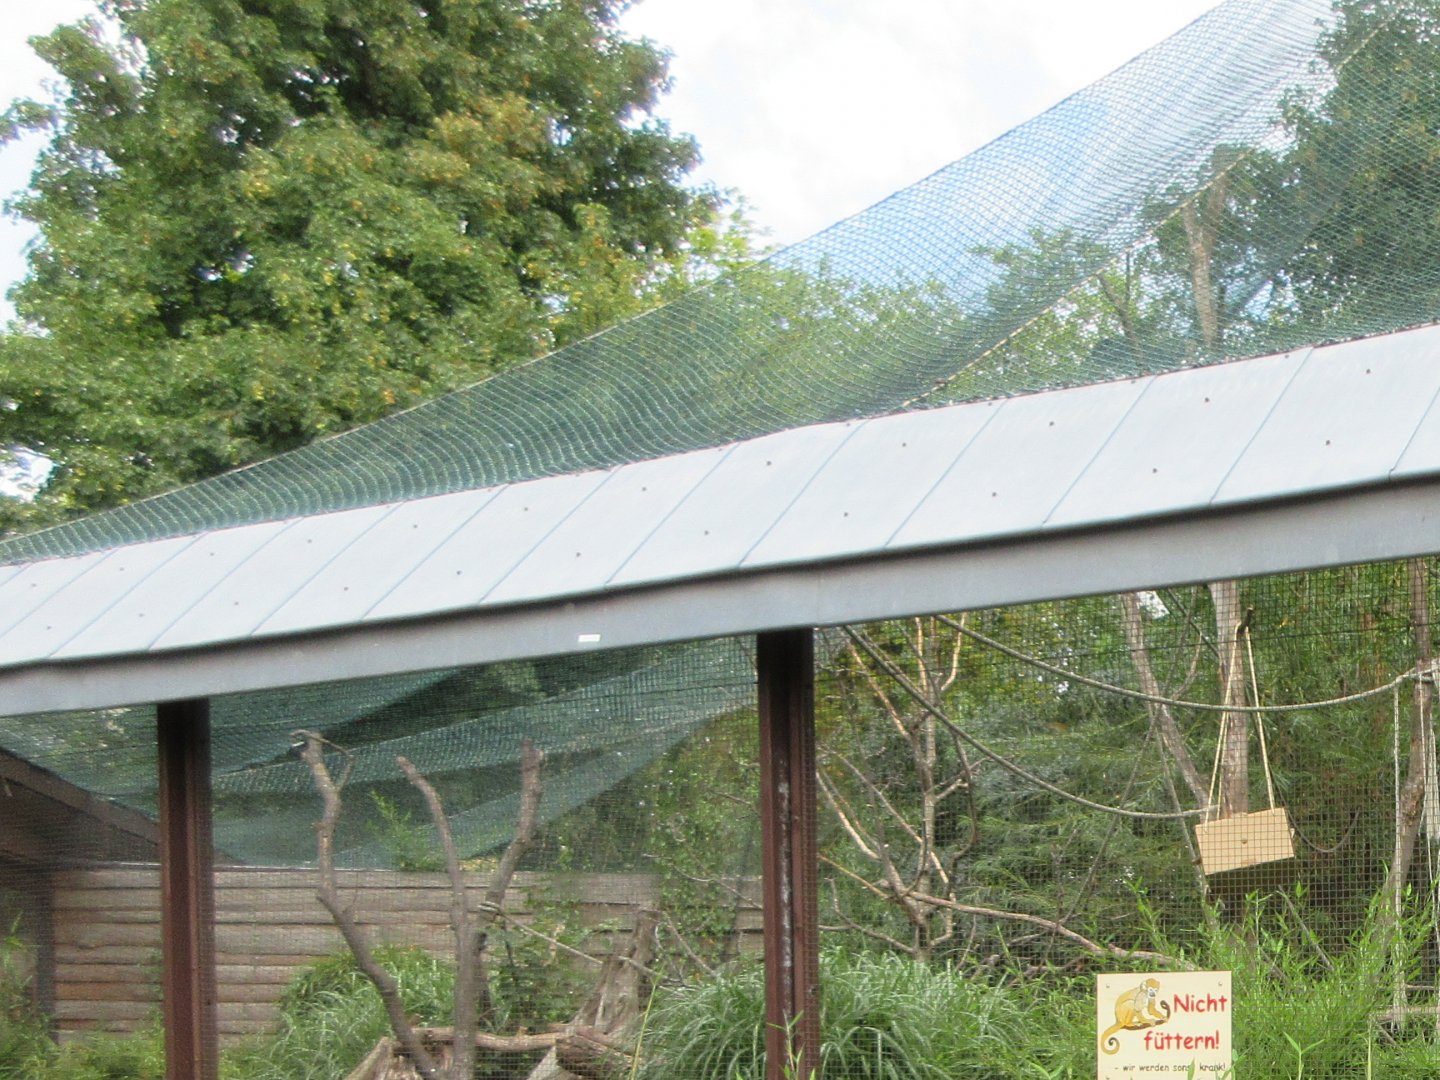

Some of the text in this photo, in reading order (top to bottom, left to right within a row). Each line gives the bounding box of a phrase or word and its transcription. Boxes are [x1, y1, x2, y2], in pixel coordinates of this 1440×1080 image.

[1174, 994, 1227, 1012] Nicht
[1144, 1030, 1220, 1051] füttern!
[1139, 1063, 1169, 1072] werden
